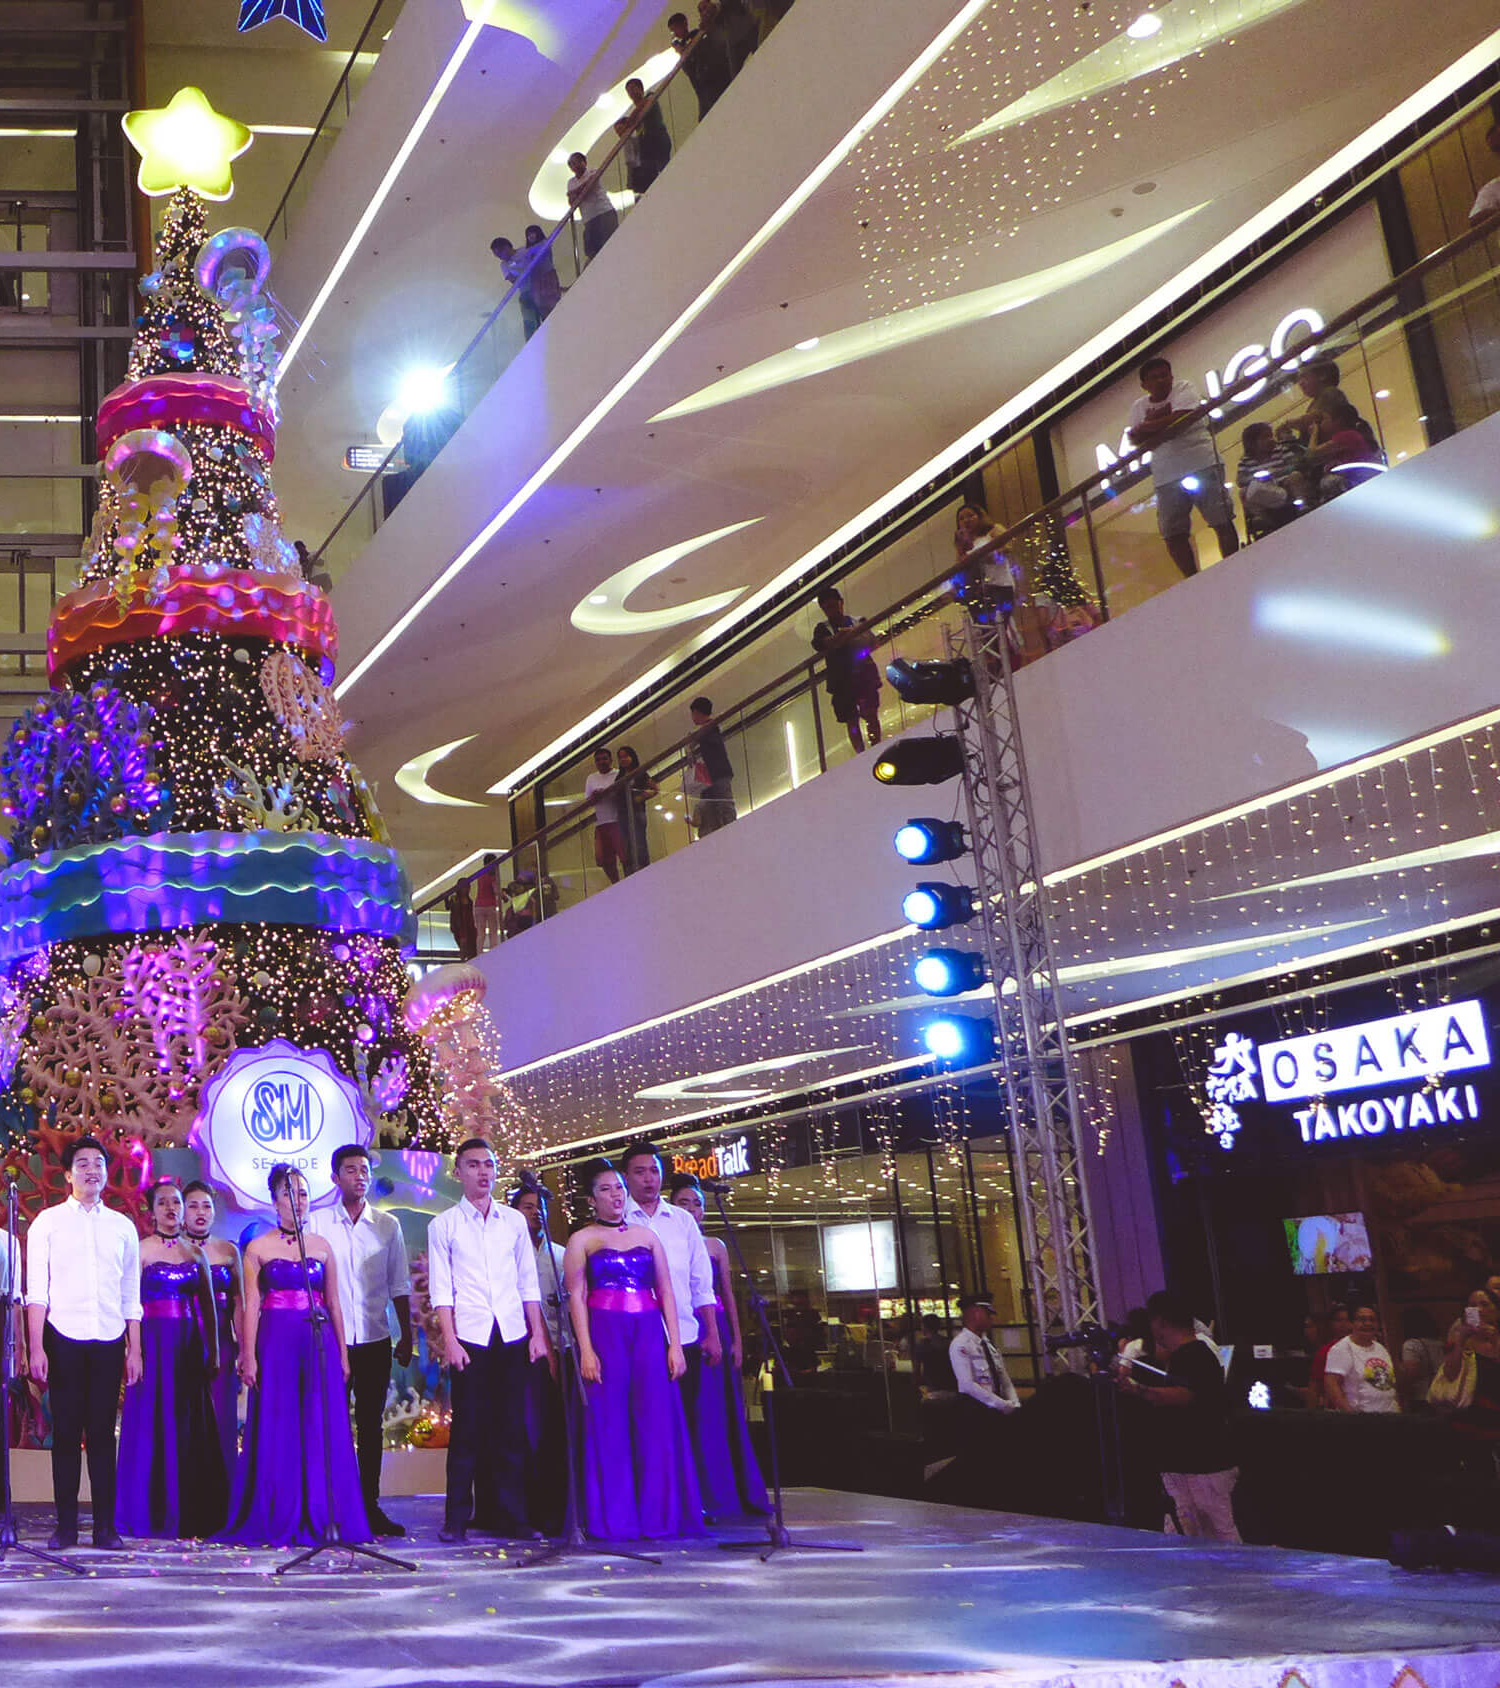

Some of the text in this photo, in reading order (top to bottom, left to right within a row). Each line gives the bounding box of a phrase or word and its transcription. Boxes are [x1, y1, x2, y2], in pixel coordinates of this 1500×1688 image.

[1096, 308, 1325, 490] MAGO
[1272, 1015, 1476, 1090] OSAKA
[250, 1081, 312, 1142] SM
[1293, 1085, 1479, 1142] TAKOYAKI
[251, 1157, 319, 1170] SEIDE
